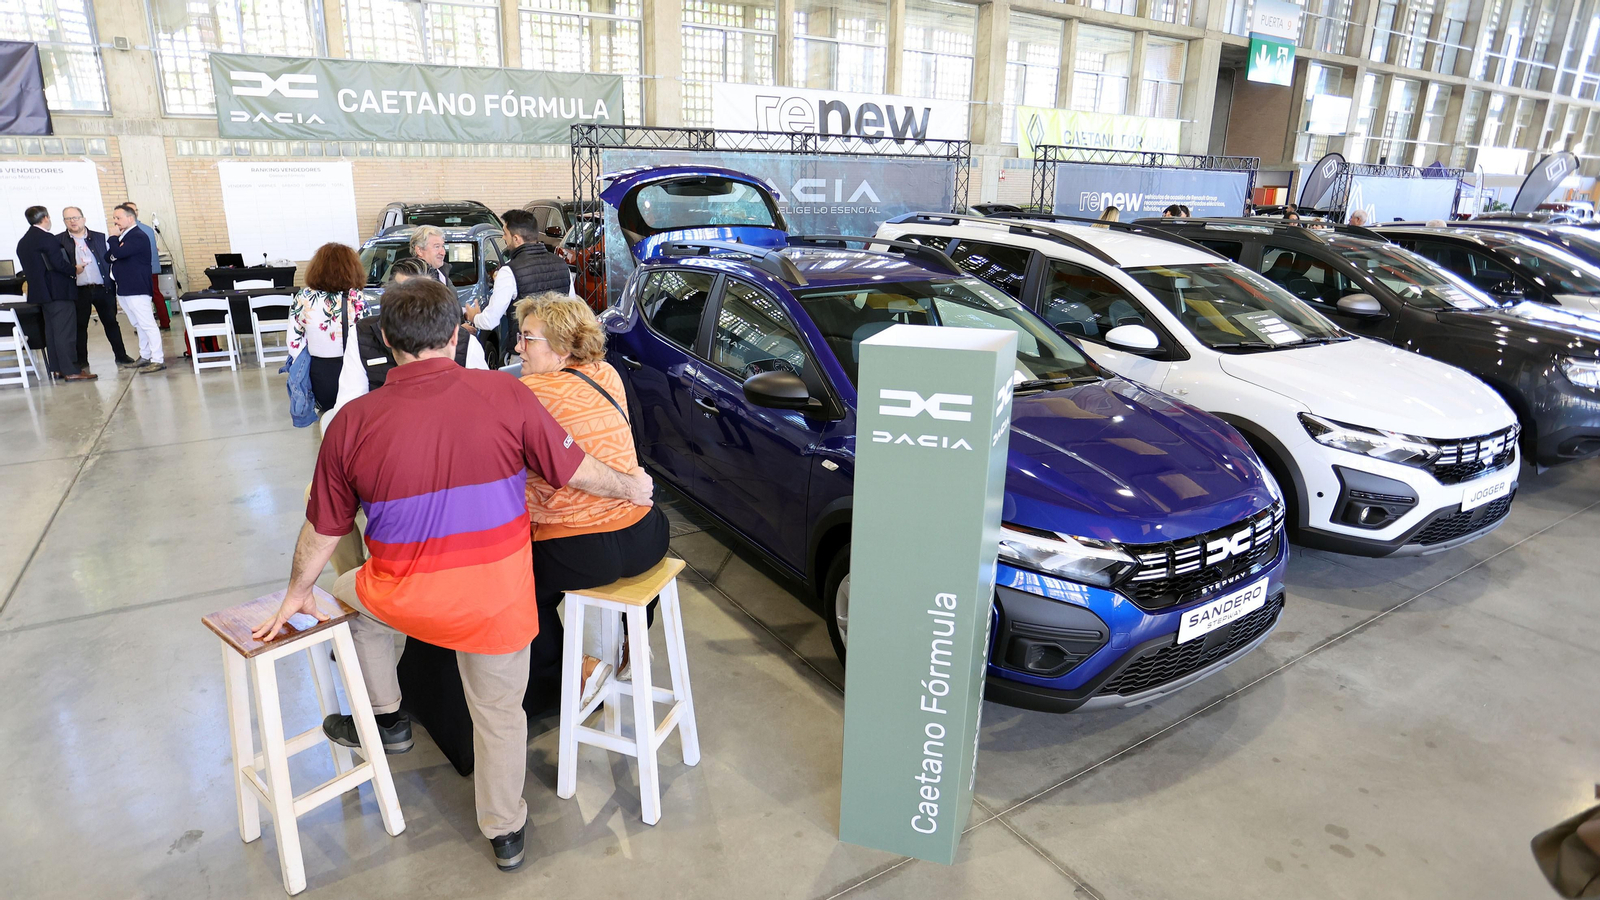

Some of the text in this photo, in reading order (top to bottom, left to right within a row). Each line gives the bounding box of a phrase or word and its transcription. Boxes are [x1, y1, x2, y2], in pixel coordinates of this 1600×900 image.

[1260, 14, 1292, 31] PUERTA 9
[337, 88, 610, 120] CAETANO FÓRMULA
[229, 110, 325, 125] DACIA
[755, 94, 932, 146] renew
[1063, 130, 1172, 151] CAETANO FÓRULA
[779, 206, 881, 215] ELIGE LO ESENCIAL
[1078, 191, 1144, 212] renew
[872, 430, 973, 451] DACIA
[1470, 481, 1505, 503] JOGGER
[1201, 571, 1246, 595] STEPWAY
[1188, 586, 1262, 628] SANDERO
[1206, 609, 1243, 630] STEPWAY
[910, 591, 958, 835] Caetano Fórmula
